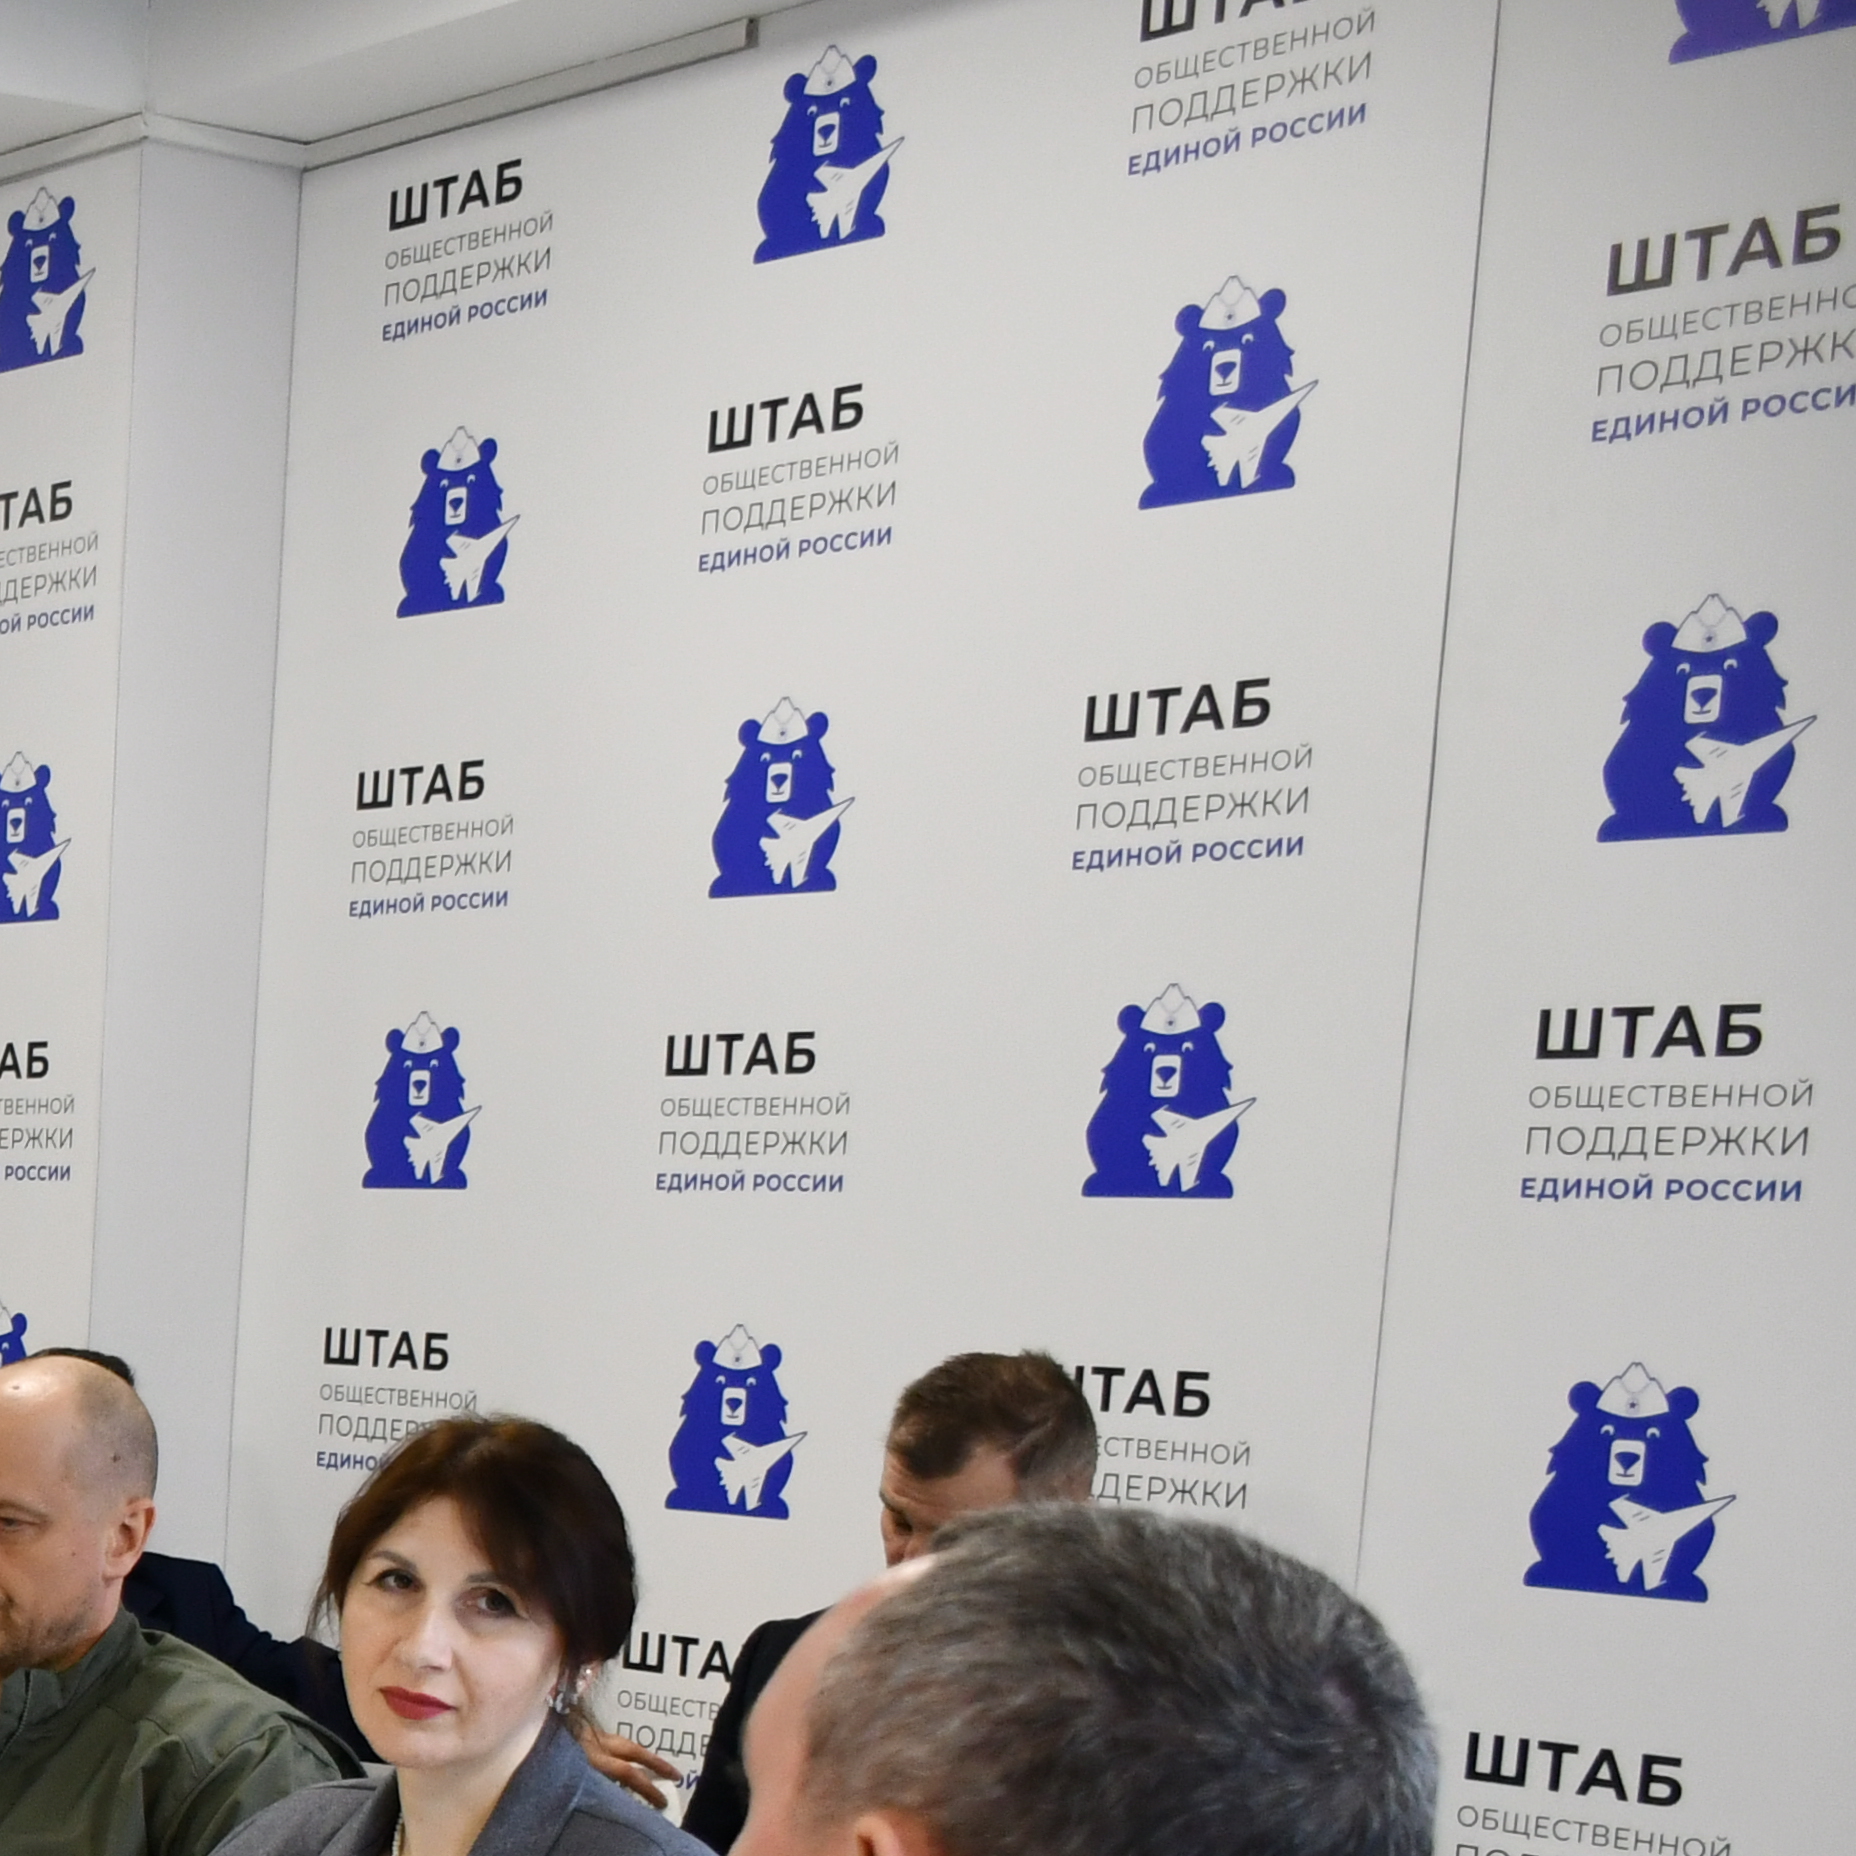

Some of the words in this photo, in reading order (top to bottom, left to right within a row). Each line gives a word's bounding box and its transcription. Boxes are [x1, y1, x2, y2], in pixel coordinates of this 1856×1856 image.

[1134, 6, 1377, 89] ОБЩЕСТВЕННОЙ
[1132, 50, 1373, 134] ПОДДЕРЖКИ
[1128, 126, 1241, 177] ЕДИНОЙ
[1251, 102, 1367, 148] РОССИИ
[389, 158, 523, 232] ШТАБ
[384, 209, 554, 271] ОБЩЕСТВЕННОЙ
[1607, 202, 1842, 296] ШТАБ
[384, 246, 551, 307] ПОДДЕРЖКИ
[382, 304, 461, 342] ЕДИНОЙ
[467, 288, 548, 323] РОССИИ
[1599, 281, 1856, 348] ОБЩЕСТВЕННО
[1597, 327, 1856, 396] ПОДДЕРЖК
[708, 383, 864, 454] ШТАБ
[1591, 396, 1730, 444] ЕДИНОЙ
[1741, 382, 1856, 421] РОССИ
[702, 440, 900, 496] ОБЩЕСТВЕННОЙ
[701, 480, 897, 535] ПОДДЕРЖКИ
[698, 537, 791, 574] ЕДИНОЙ
[798, 526, 892, 558] РОССИИ
[26, 604, 95, 631] РОССИИ
[1084, 677, 1271, 743] ШТАБ
[356, 759, 485, 811] ШТАБ
[1077, 742, 1313, 788] ОБЩЕСТВЕННОЙ
[352, 814, 514, 849] ОБЩЕСТВЕННОЙ
[1076, 786, 1310, 832] ПОДДЕРЖКИ
[351, 849, 512, 885] ПОДДЕРЖКИ
[1072, 839, 1183, 873] ЕДИНОЙ
[1191, 835, 1304, 863] РОССИИ
[348, 892, 425, 919] ЕДИНОЙ
[430, 890, 509, 912] РОССИИ
[665, 1031, 816, 1077] ШТАБ
[1536, 1003, 1763, 1060] ШТАБ
[660, 1092, 851, 1119] ОБЩЕСТВЕННОЙ
[1528, 1077, 1814, 1112] ОБЩЕСТВЕННОЙ
[658, 1130, 848, 1160] ПОДДЕРЖКИ
[1525, 1126, 1810, 1161] ПОДДЕРЖКИ
[4, 1164, 71, 1182] РОССИИ
[655, 1169, 746, 1194] ЕДИНОЙ
[752, 1173, 844, 1193] РОССИИ
[1520, 1173, 1654, 1203] ЕДИНОЙ
[1665, 1178, 1803, 1202] РОССИИ
[323, 1326, 450, 1371] ШТАБ
[319, 1383, 478, 1411] ОБЩЕСТВЕННОЙ
[1073, 1364, 1211, 1419] ТАБ
[318, 1413, 425, 1444] ПОДДЕР
[1096, 1434, 1252, 1467] СТВЕННОЙ
[1089, 1472, 1248, 1511] ДЕРЖКИ
[622, 1631, 732, 1683] ШТА
[617, 1689, 724, 1722] ОБЩЕСТВ
[616, 1721, 713, 1761] ПОДДЕ
[1463, 1730, 1683, 1807] ШТАБ
